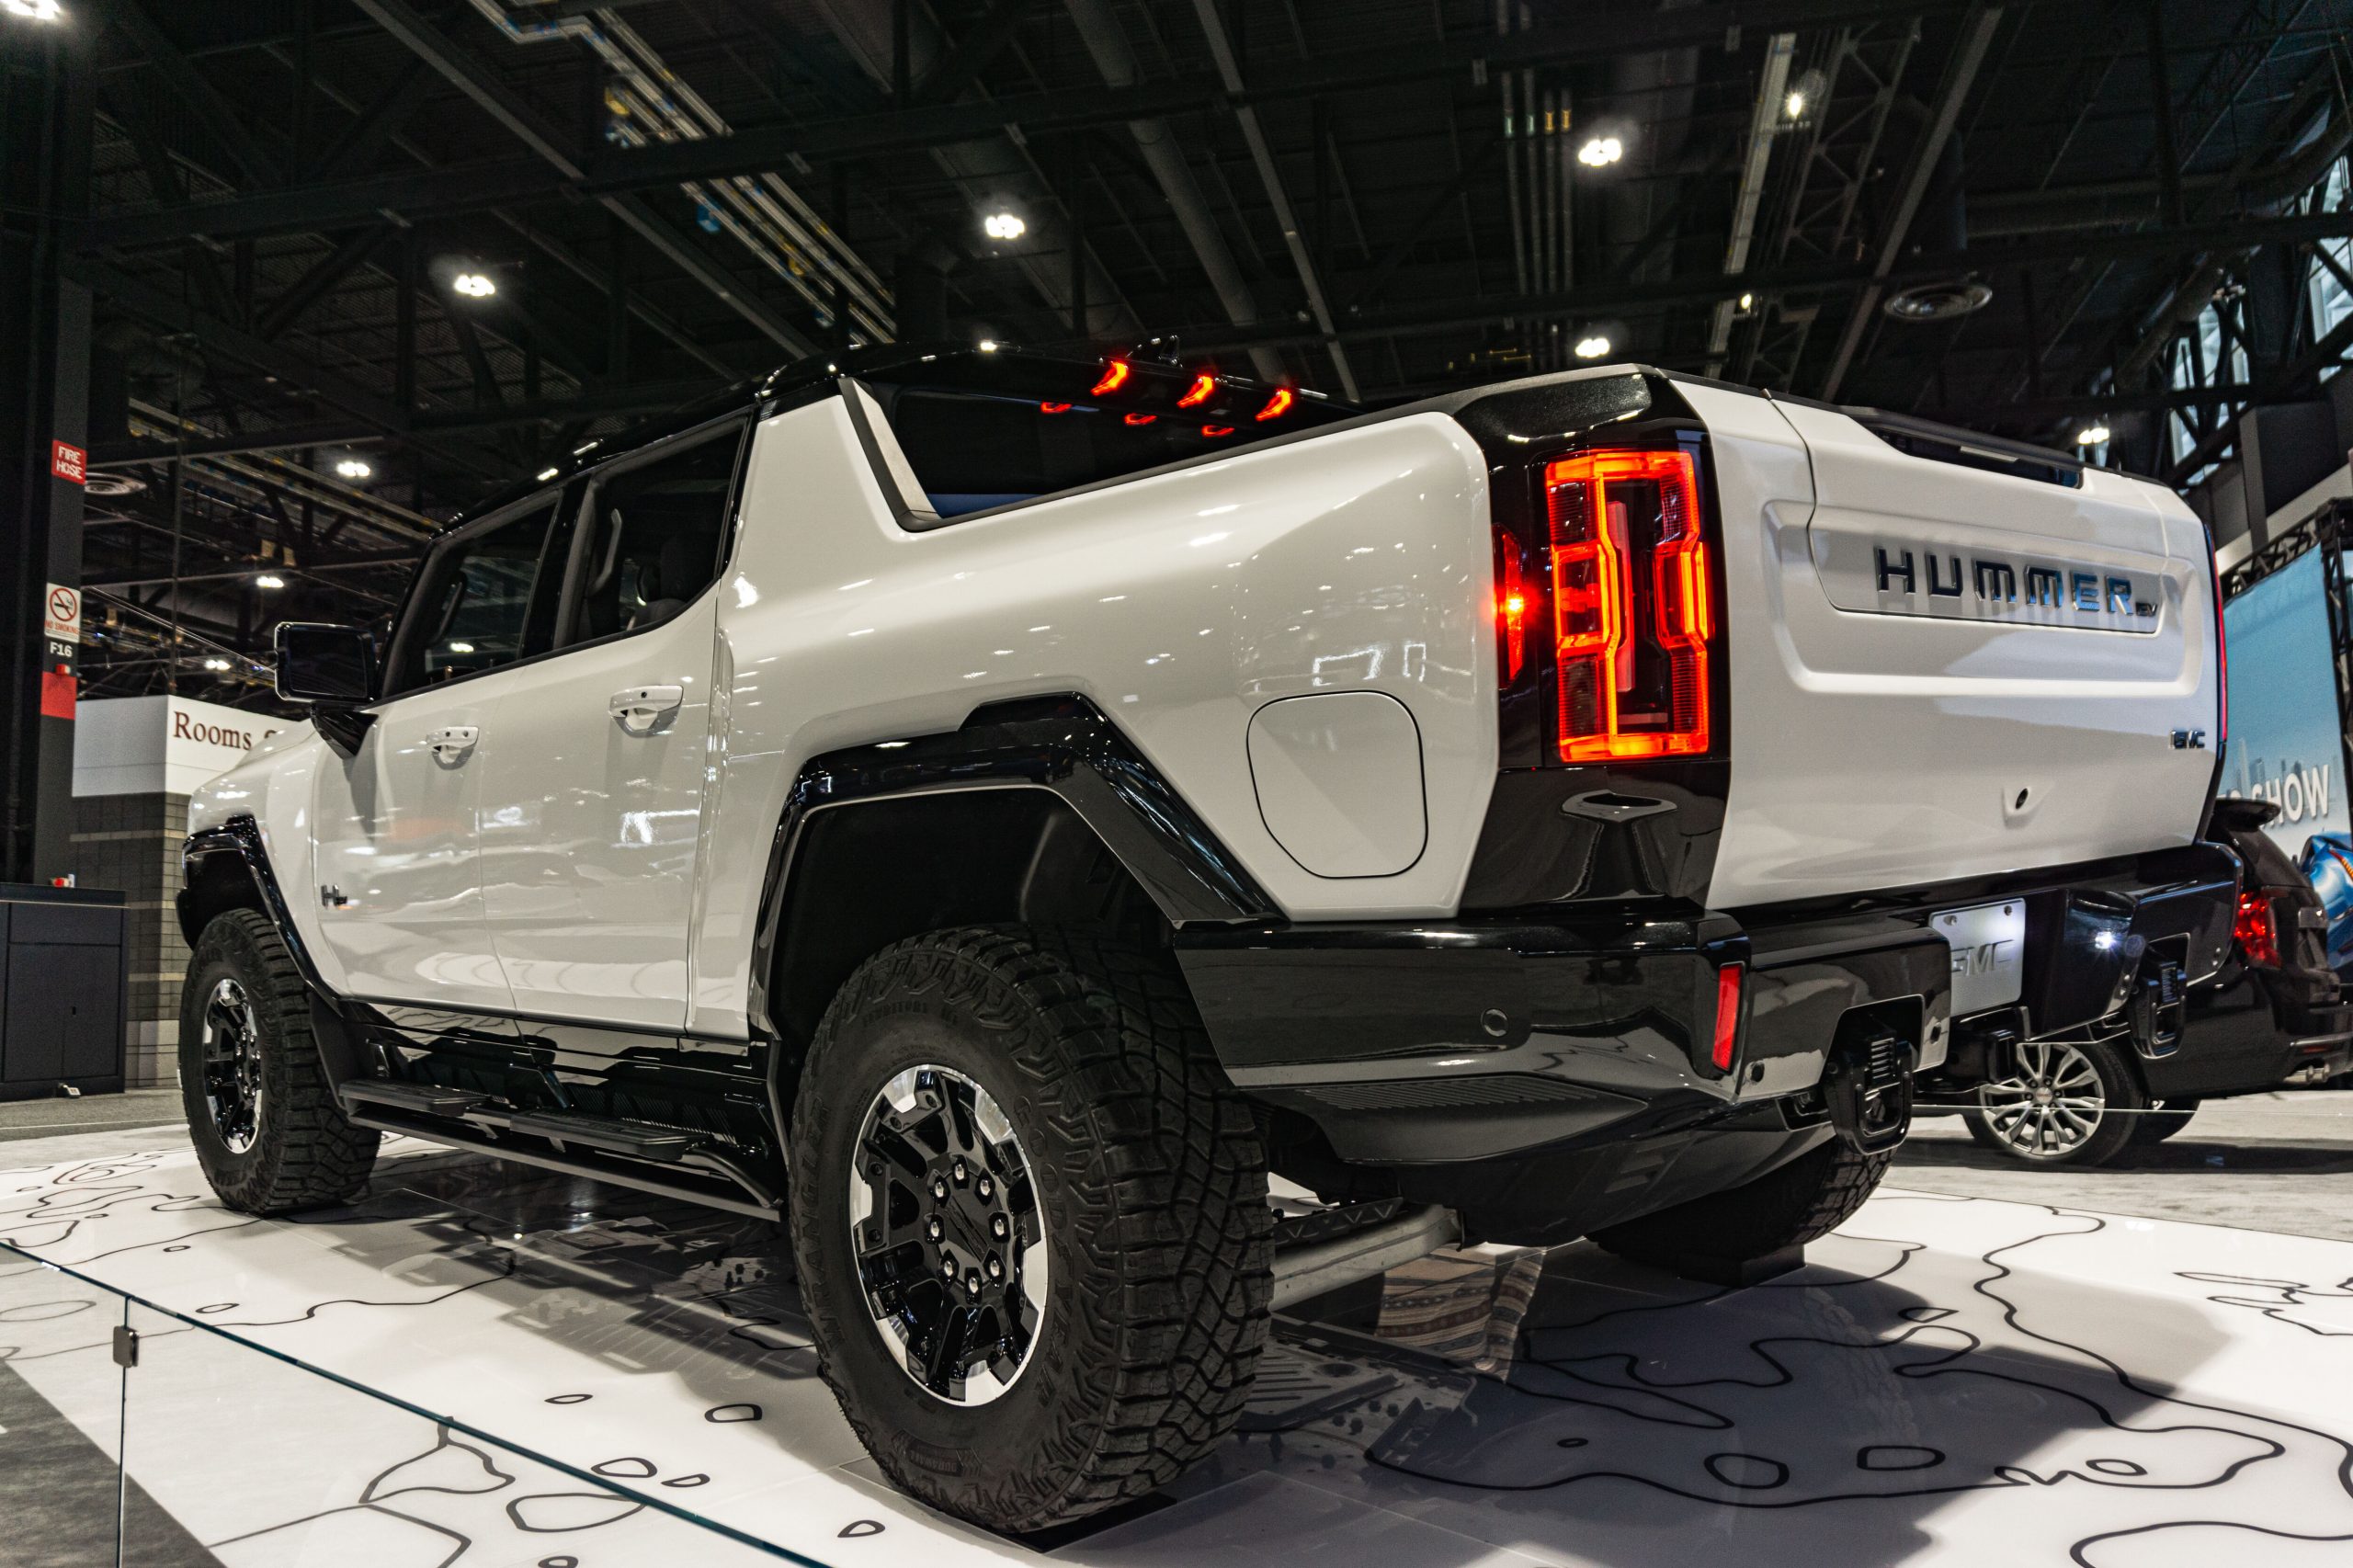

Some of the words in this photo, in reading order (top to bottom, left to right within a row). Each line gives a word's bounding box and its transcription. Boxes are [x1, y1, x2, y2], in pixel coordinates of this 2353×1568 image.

[56, 460, 83, 479] HOSE
[58, 446, 82, 464] FIRE
[1873, 545, 2132, 616] HUMMER
[50, 642, 73, 657] F16
[173, 710, 253, 751] Rooms
[800, 1096, 847, 1352] WRANGLER
[1014, 1095, 1074, 1407] GOODYEAR
